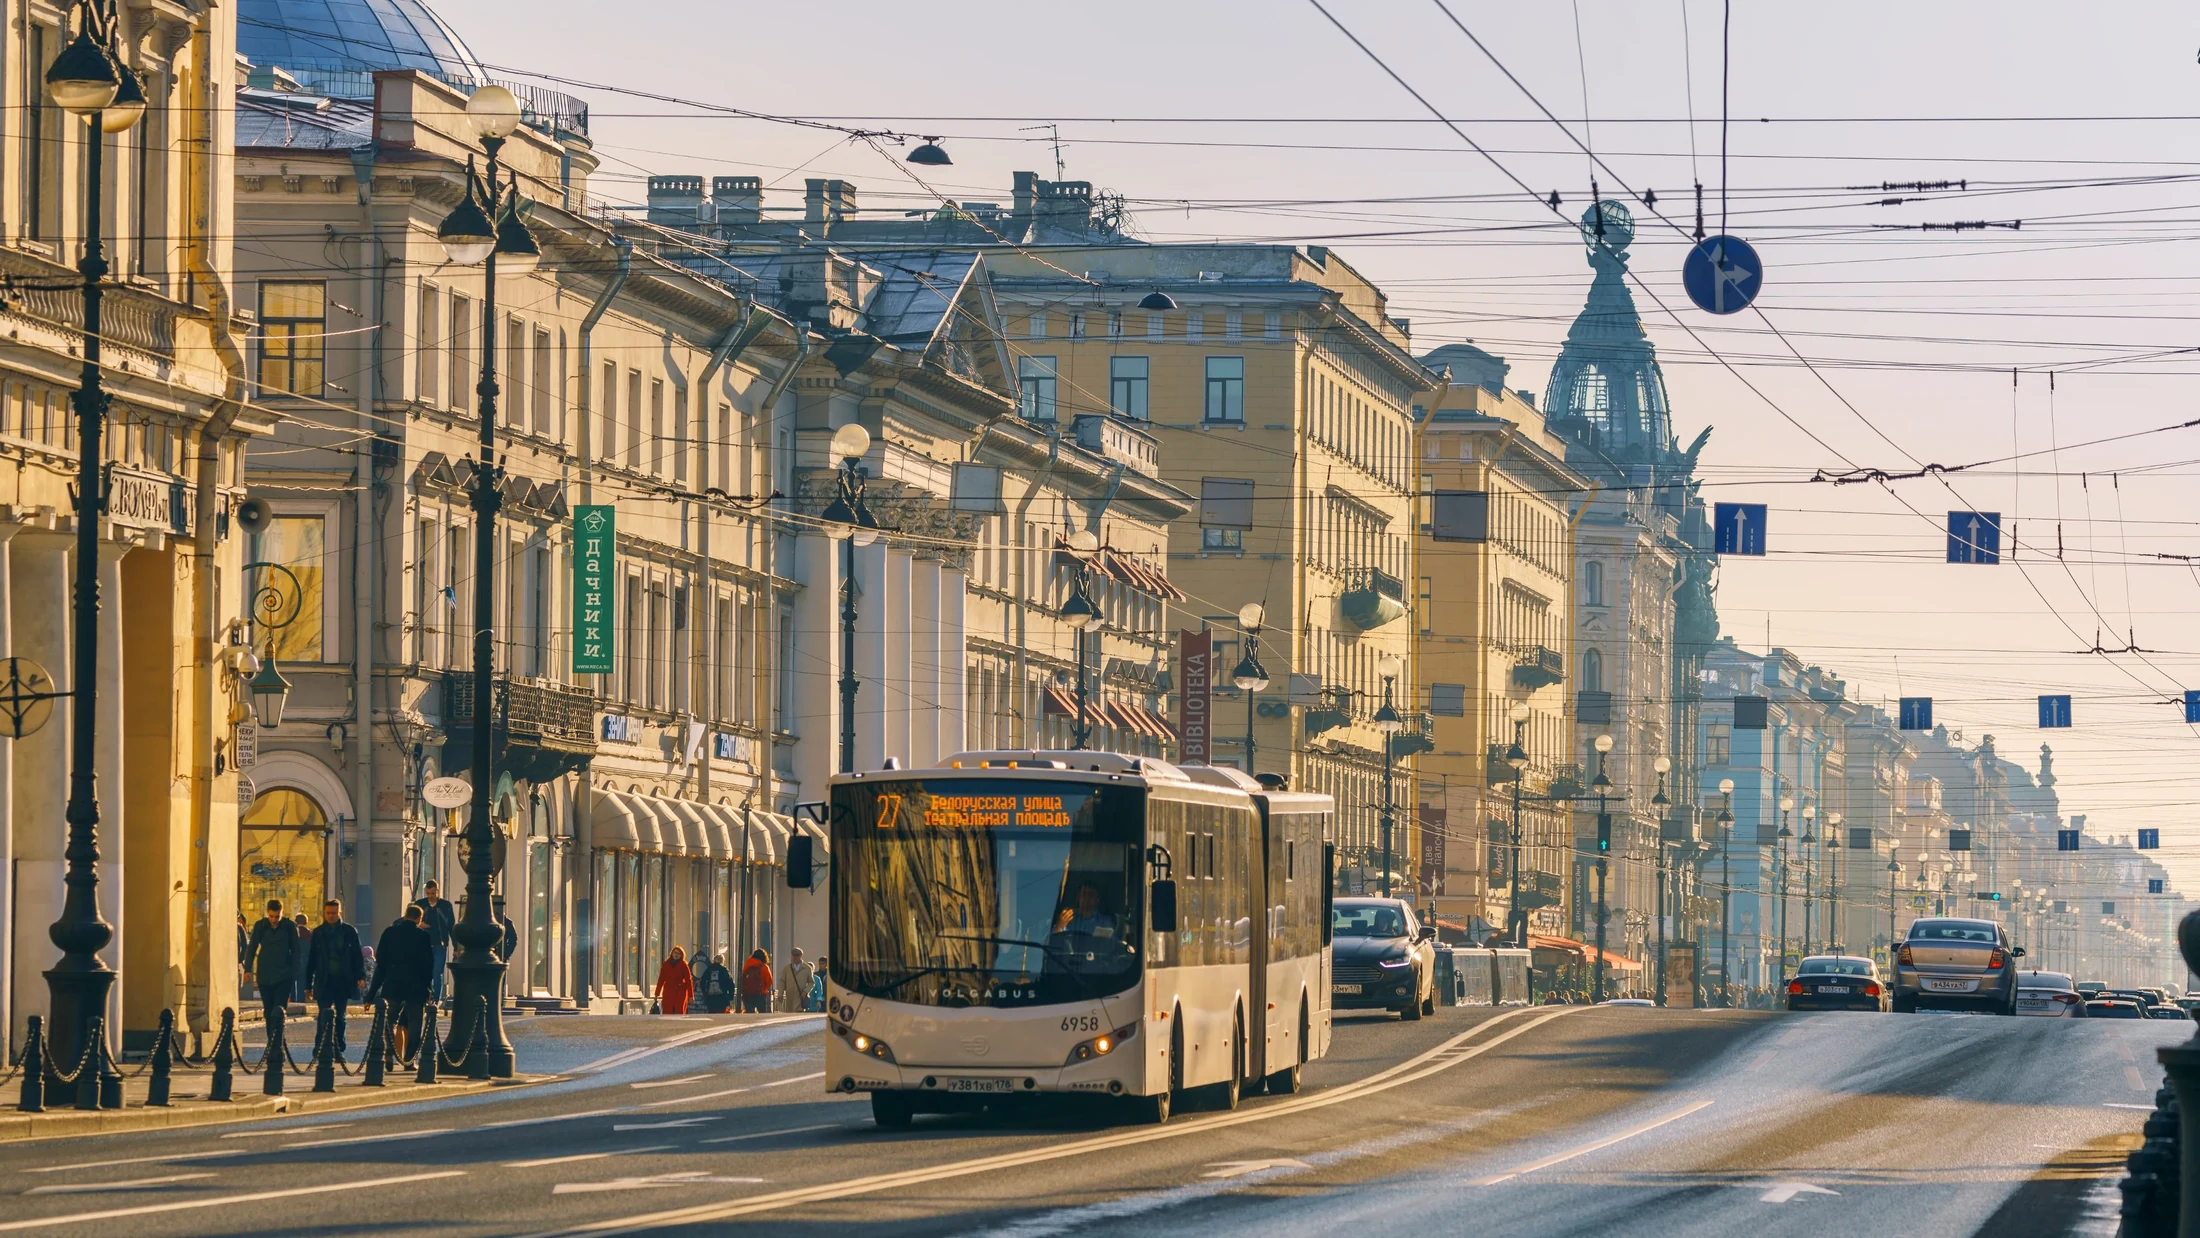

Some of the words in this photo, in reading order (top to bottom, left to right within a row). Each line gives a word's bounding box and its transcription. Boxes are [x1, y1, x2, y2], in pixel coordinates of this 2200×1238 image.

[1185, 653, 1205, 756] BIBLIOTEKA
[429, 784, 443, 793] The
[877, 795, 902, 828] 27
[931, 795, 1017, 812] Белорусская
[1023, 796, 1063, 812] улица
[924, 811, 1009, 827] Театральная
[1425, 845, 1434, 865] две
[928, 989, 1036, 999] VOLGABUS
[1060, 1016, 1099, 1032] 6958
[994, 1079, 1011, 1089] 178
